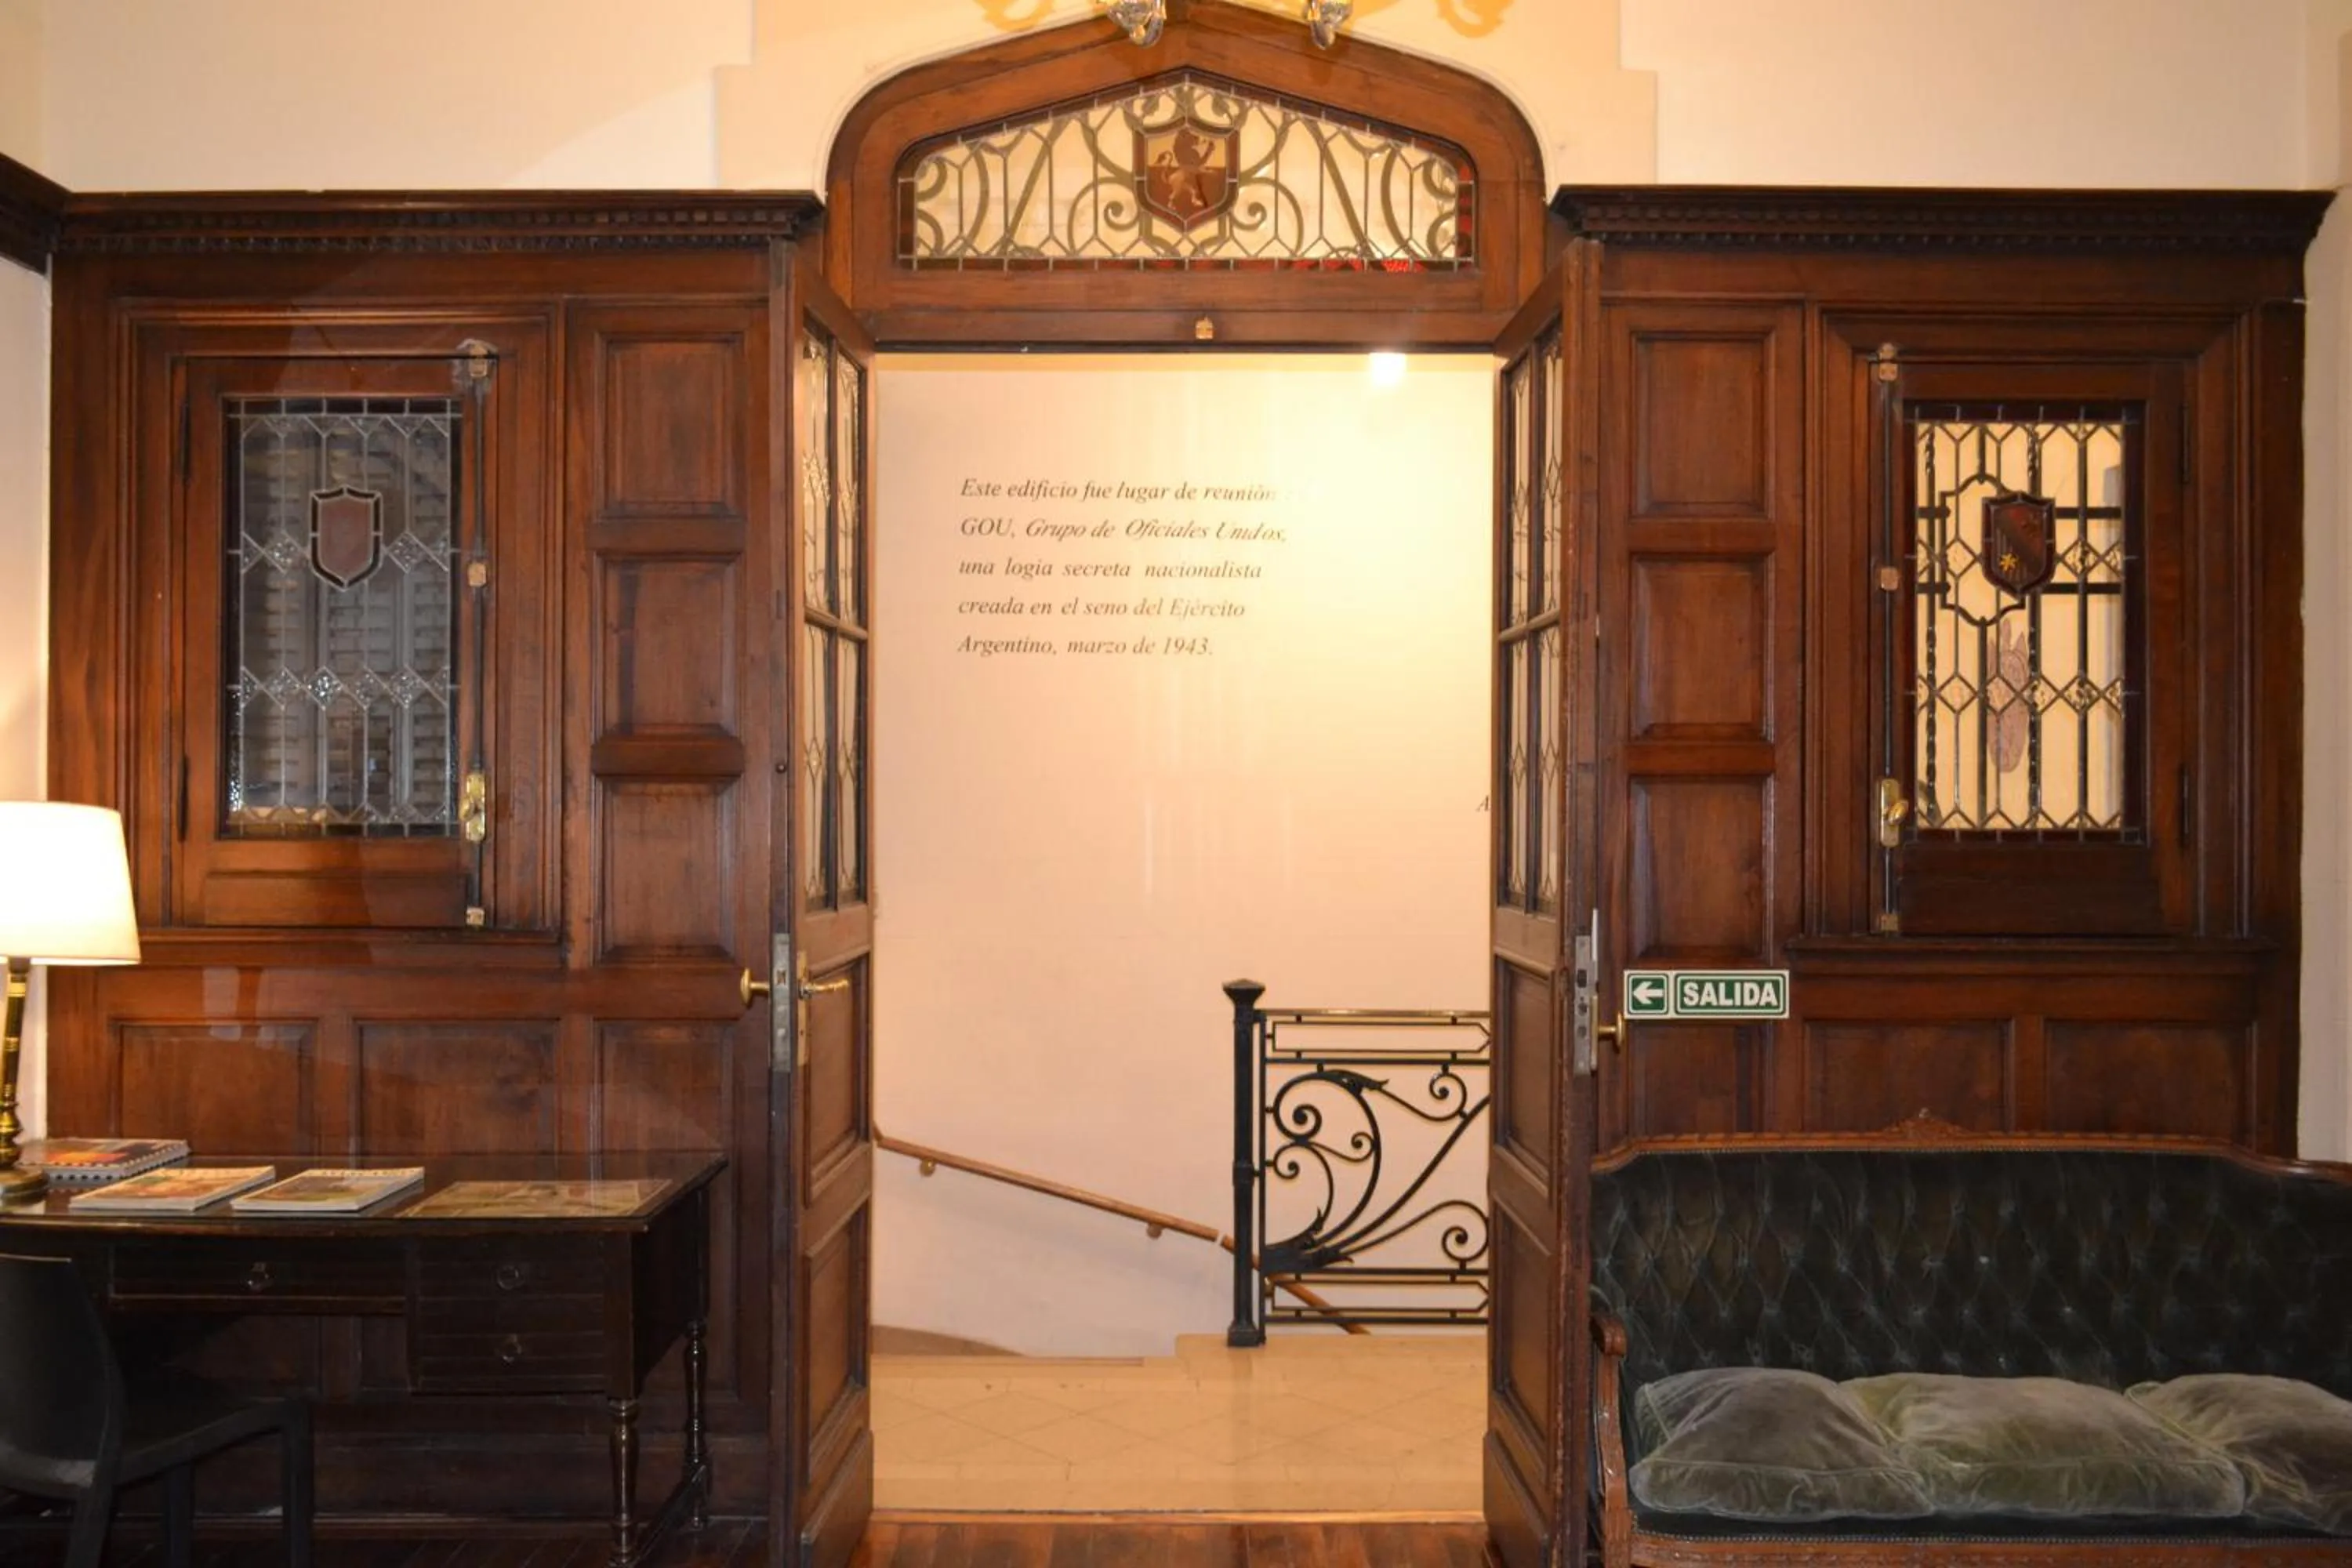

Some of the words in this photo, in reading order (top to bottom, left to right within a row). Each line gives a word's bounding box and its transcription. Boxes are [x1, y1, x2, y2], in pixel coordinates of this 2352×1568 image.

[960, 478, 1002, 497] Este
[1007, 479, 1078, 500] edificio
[1083, 481, 1112, 502] fue
[1116, 481, 1170, 503] lugar
[1174, 481, 1198, 500] de
[960, 518, 1015, 539] GOU,
[1025, 519, 1087, 543] Grupo
[1091, 519, 1116, 538] de
[1125, 519, 1207, 539] Oficiales
[959, 561, 995, 575] una
[1062, 563, 1131, 578] secreta
[1145, 561, 1262, 579] nacionalista
[957, 597, 1025, 615] creada
[1029, 602, 1052, 615] en
[1061, 597, 1079, 615] el
[1083, 603, 1128, 615] seno
[1133, 597, 1164, 616] del
[1170, 598, 1246, 619] Ejército
[956, 635, 1058, 657] Argentino,
[1067, 641, 1127, 654] marzo
[1132, 636, 1156, 655] de
[1163, 637, 1213, 656] 1943.
[1683, 982, 1778, 1007] SALIDA
